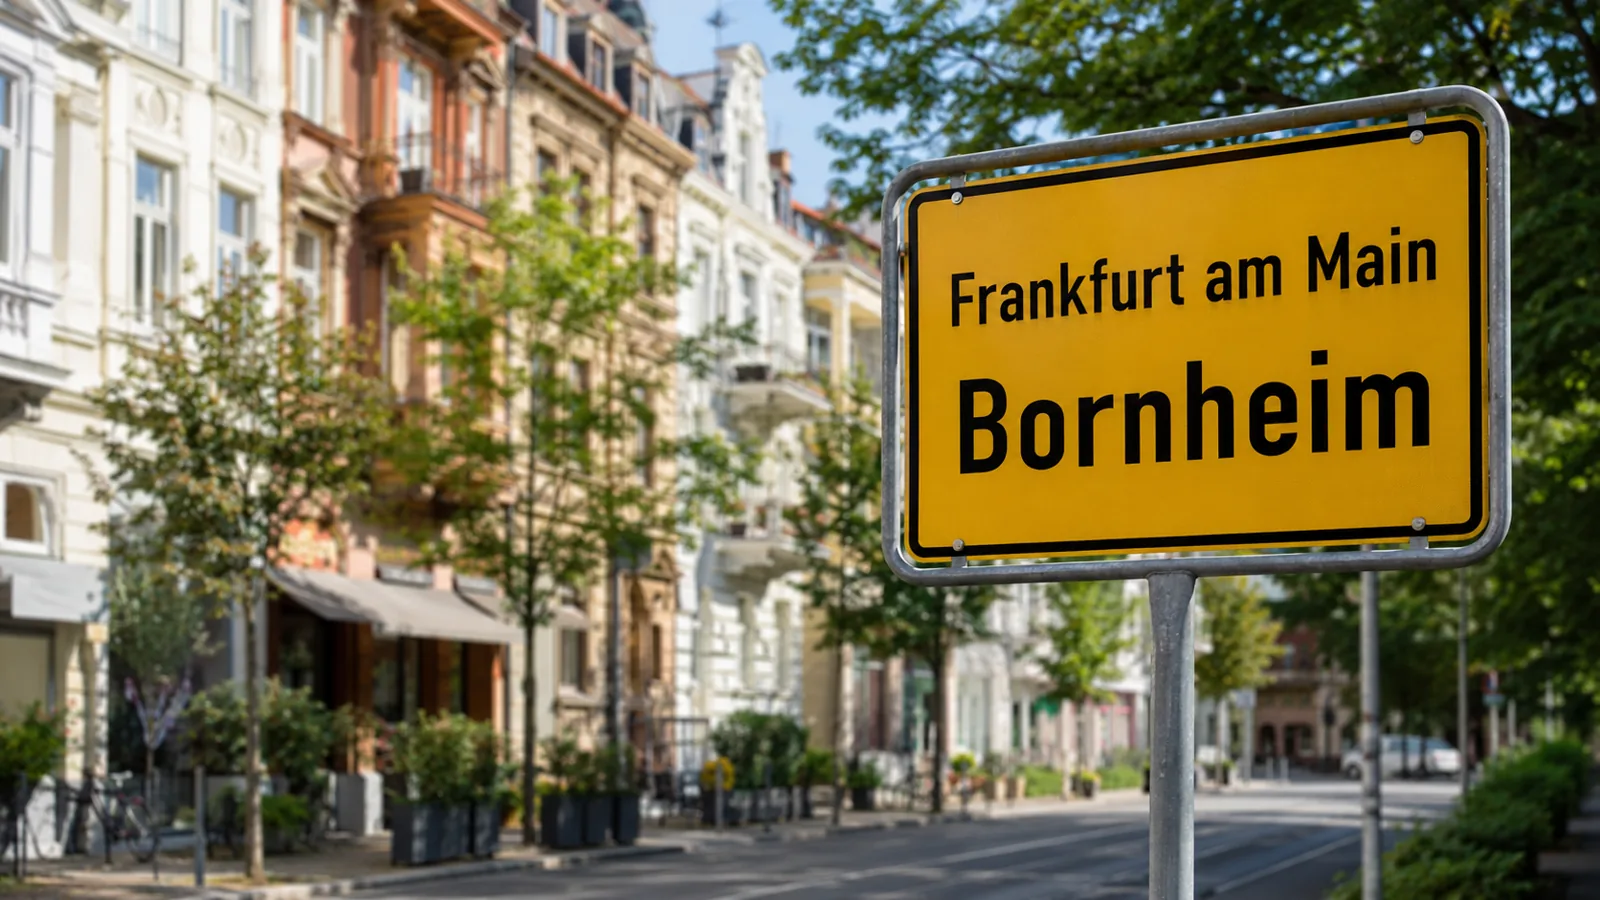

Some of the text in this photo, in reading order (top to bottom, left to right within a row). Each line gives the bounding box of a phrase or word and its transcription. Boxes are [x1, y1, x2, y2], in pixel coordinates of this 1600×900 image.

[951, 225, 1437, 328] Frankfurt am Main
[959, 349, 1430, 475] Bornheim
